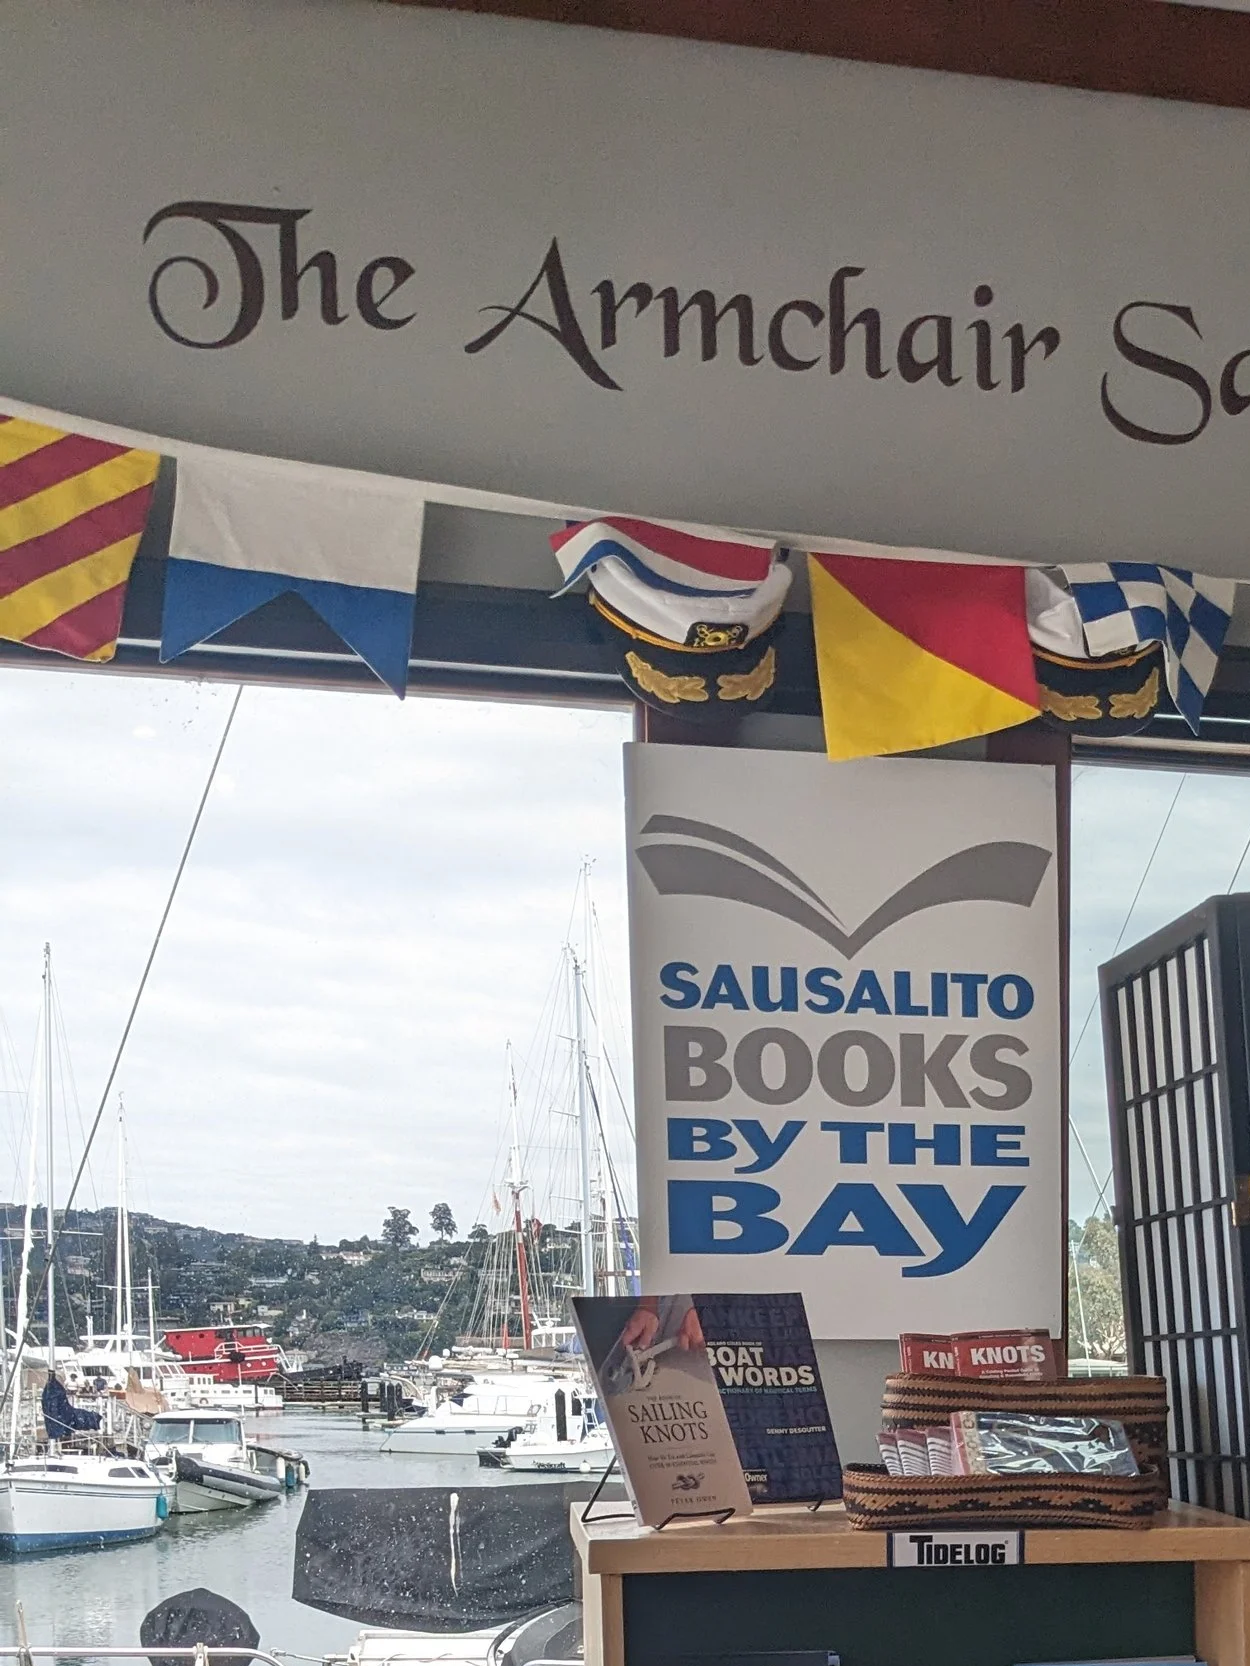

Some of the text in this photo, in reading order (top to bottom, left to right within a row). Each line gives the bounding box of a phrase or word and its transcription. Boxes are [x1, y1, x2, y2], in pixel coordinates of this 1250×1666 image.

[142, 200, 417, 350] The
[464, 236, 1061, 391] Armchair
[659, 962, 1035, 1020] SAUSALITO
[663, 1025, 1033, 1111] BOOKS
[820, 1121, 1030, 1167] THE
[706, 1346, 763, 1366] BOAT
[970, 1344, 1046, 1365] KNOTS
[718, 1365, 815, 1387] WORDS
[628, 1401, 707, 1423] SAILING
[640, 1422, 708, 1444] KNOTS
[745, 1473, 768, 1482] Owner
